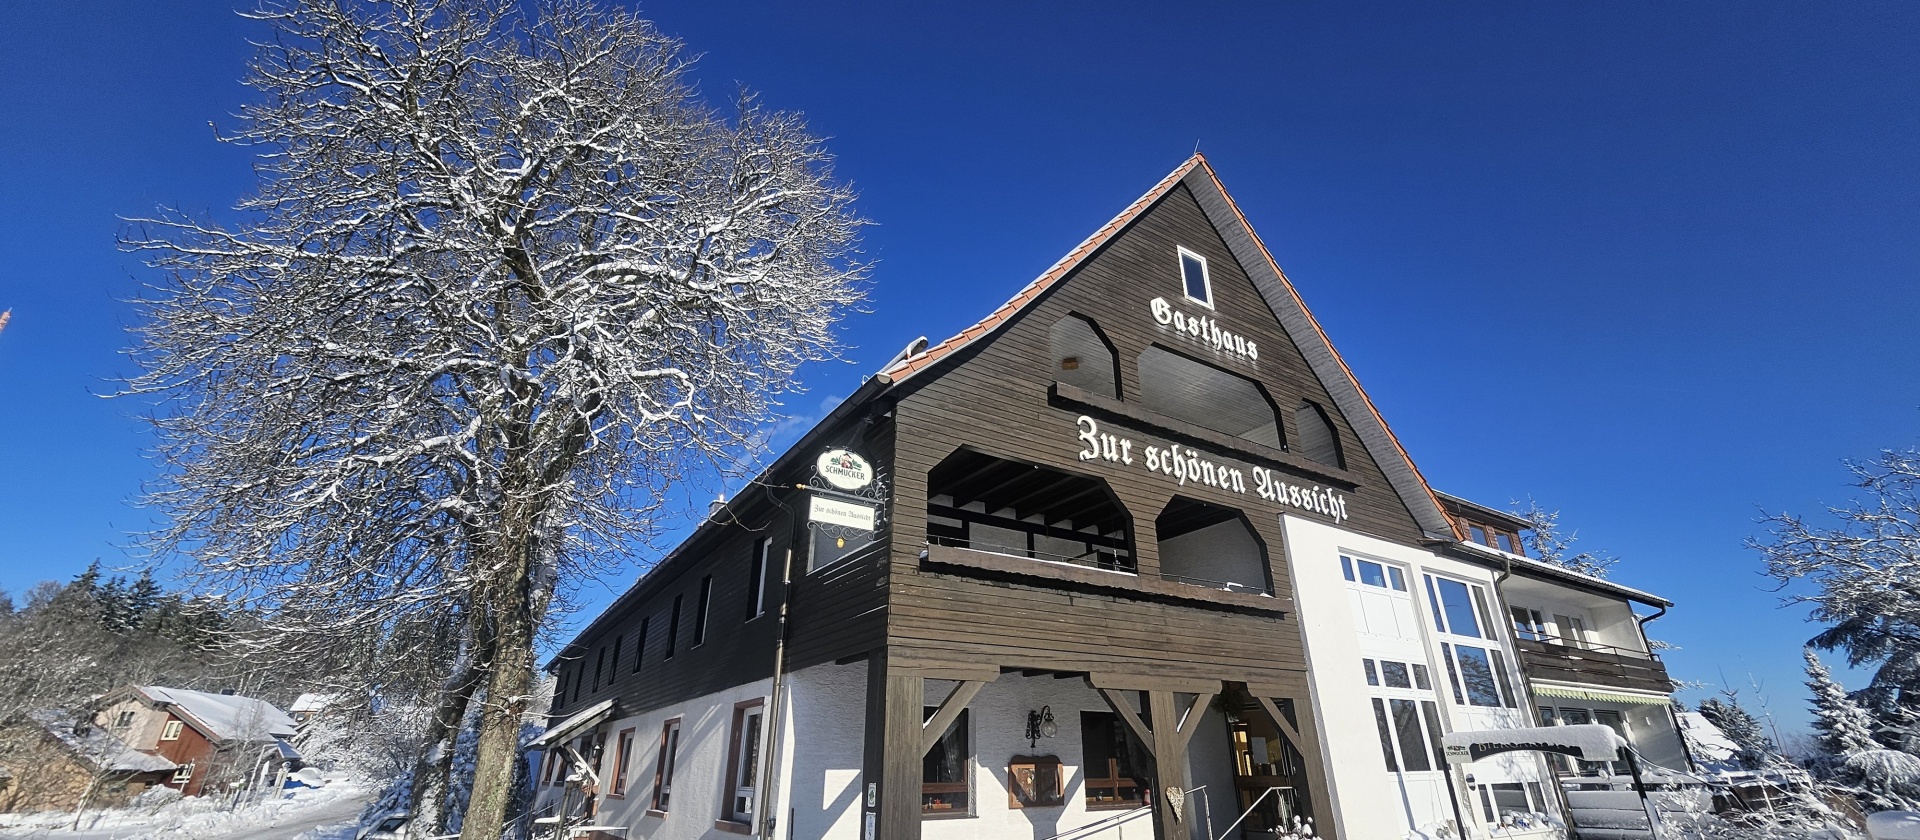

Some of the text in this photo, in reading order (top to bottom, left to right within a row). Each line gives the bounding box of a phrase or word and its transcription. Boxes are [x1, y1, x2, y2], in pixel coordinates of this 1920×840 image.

[1150, 297, 1258, 360] Gasthaus
[825, 465, 865, 480] SCHMUCKER
[1076, 415, 1348, 524] Zur schönen Aussicht
